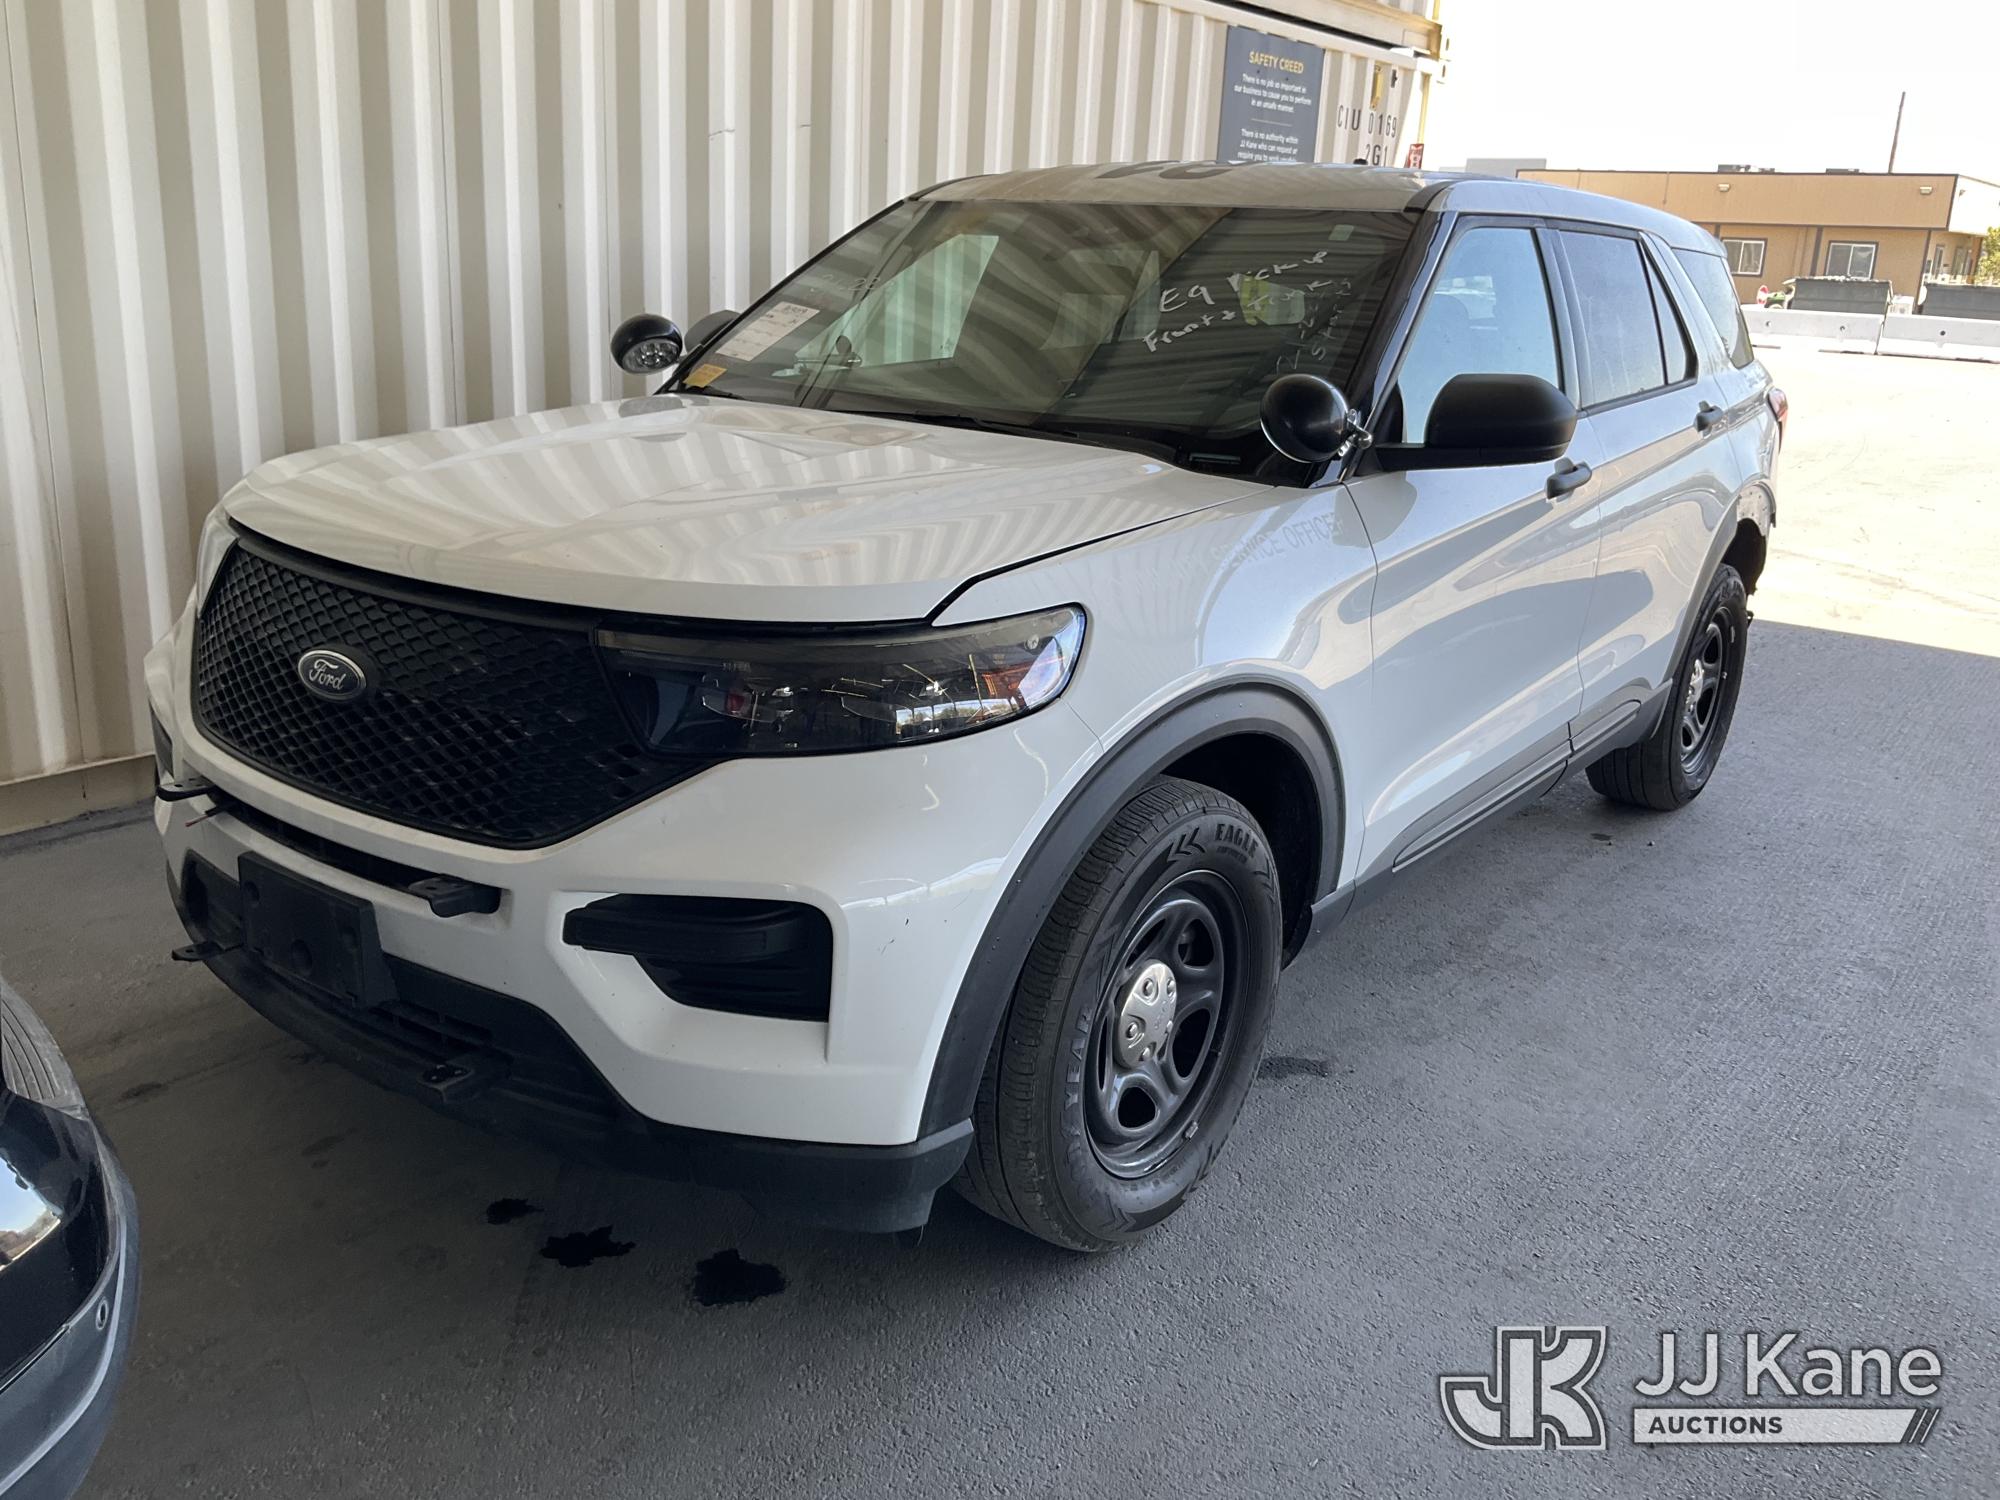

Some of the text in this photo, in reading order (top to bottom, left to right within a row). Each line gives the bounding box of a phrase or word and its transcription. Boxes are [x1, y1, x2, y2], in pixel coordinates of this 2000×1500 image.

[1248, 51, 1304, 74] SAFETY CREED
[1242, 73, 1255, 84] There
[1241, 127, 1254, 138] There
[308, 659, 347, 690] Ford
[1215, 823, 1259, 858] EAGLE
